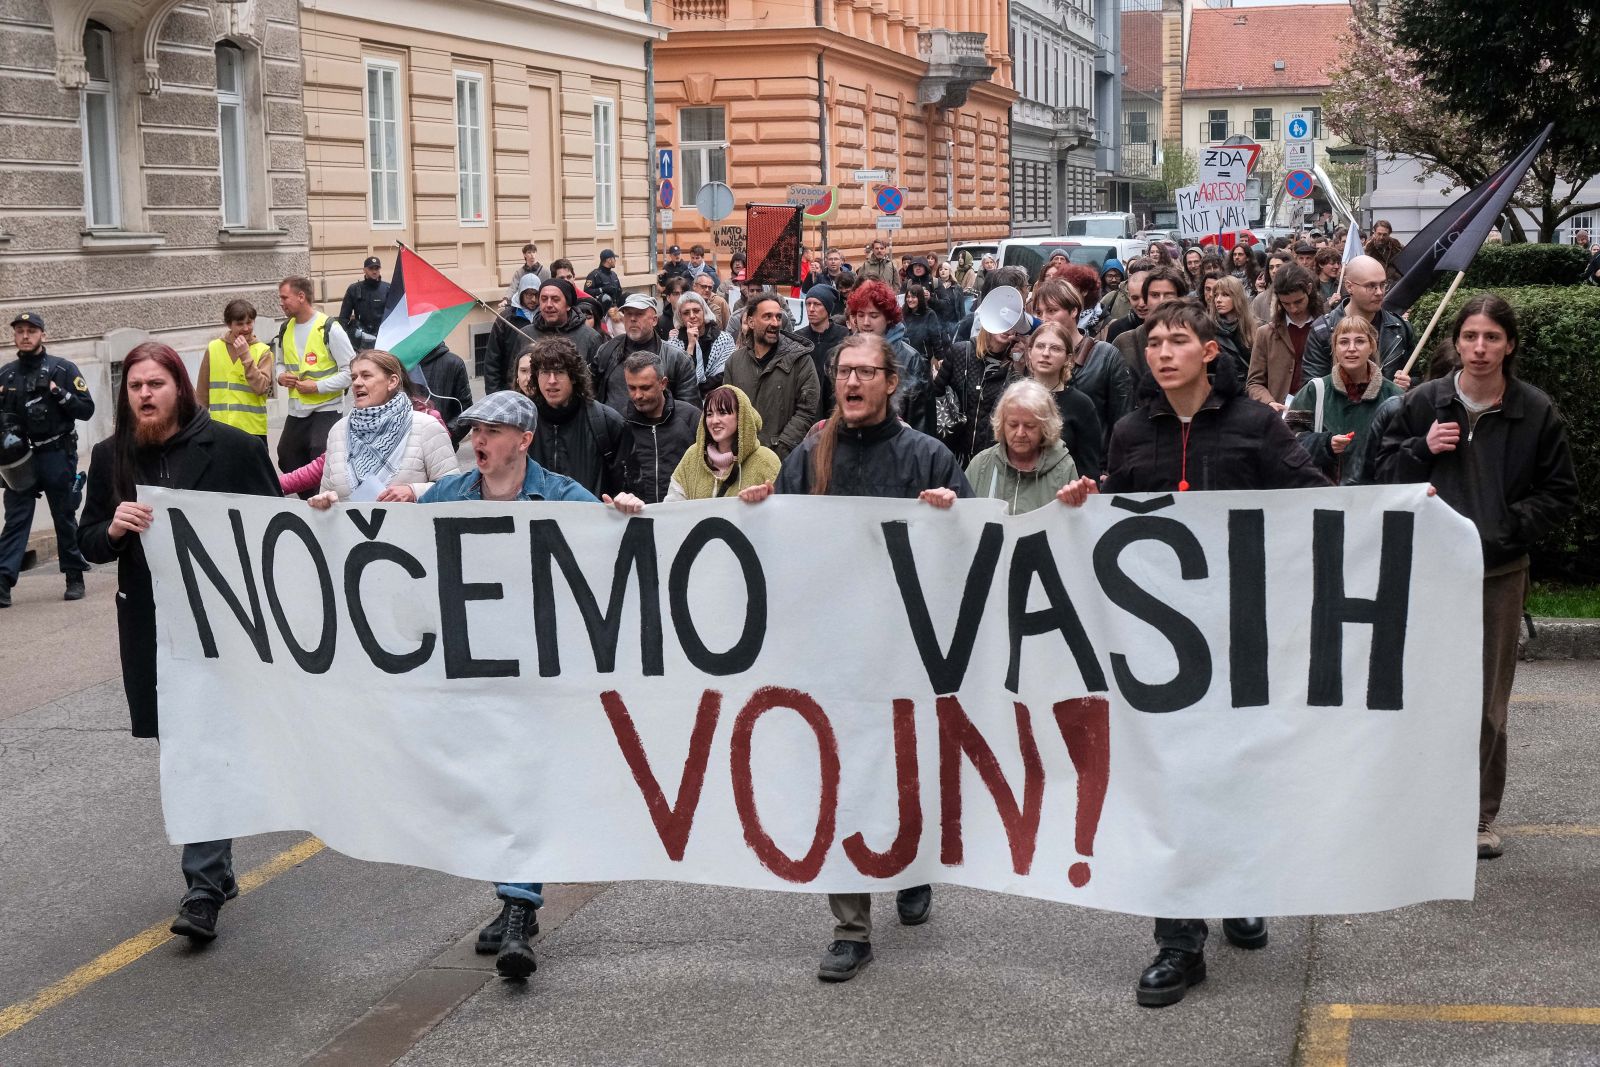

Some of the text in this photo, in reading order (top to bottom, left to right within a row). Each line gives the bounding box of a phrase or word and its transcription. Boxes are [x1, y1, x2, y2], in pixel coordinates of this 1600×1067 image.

[1204, 150, 1246, 168] ZDA
[791, 186, 826, 195] SVOBODA
[1198, 181, 1246, 203] AGRESOR
[720, 226, 742, 235] NATO
[1182, 210, 1210, 234] NOT
[168, 494, 1414, 713] NOČEMO VAŠIH
[601, 686, 1110, 888] VOJN!
